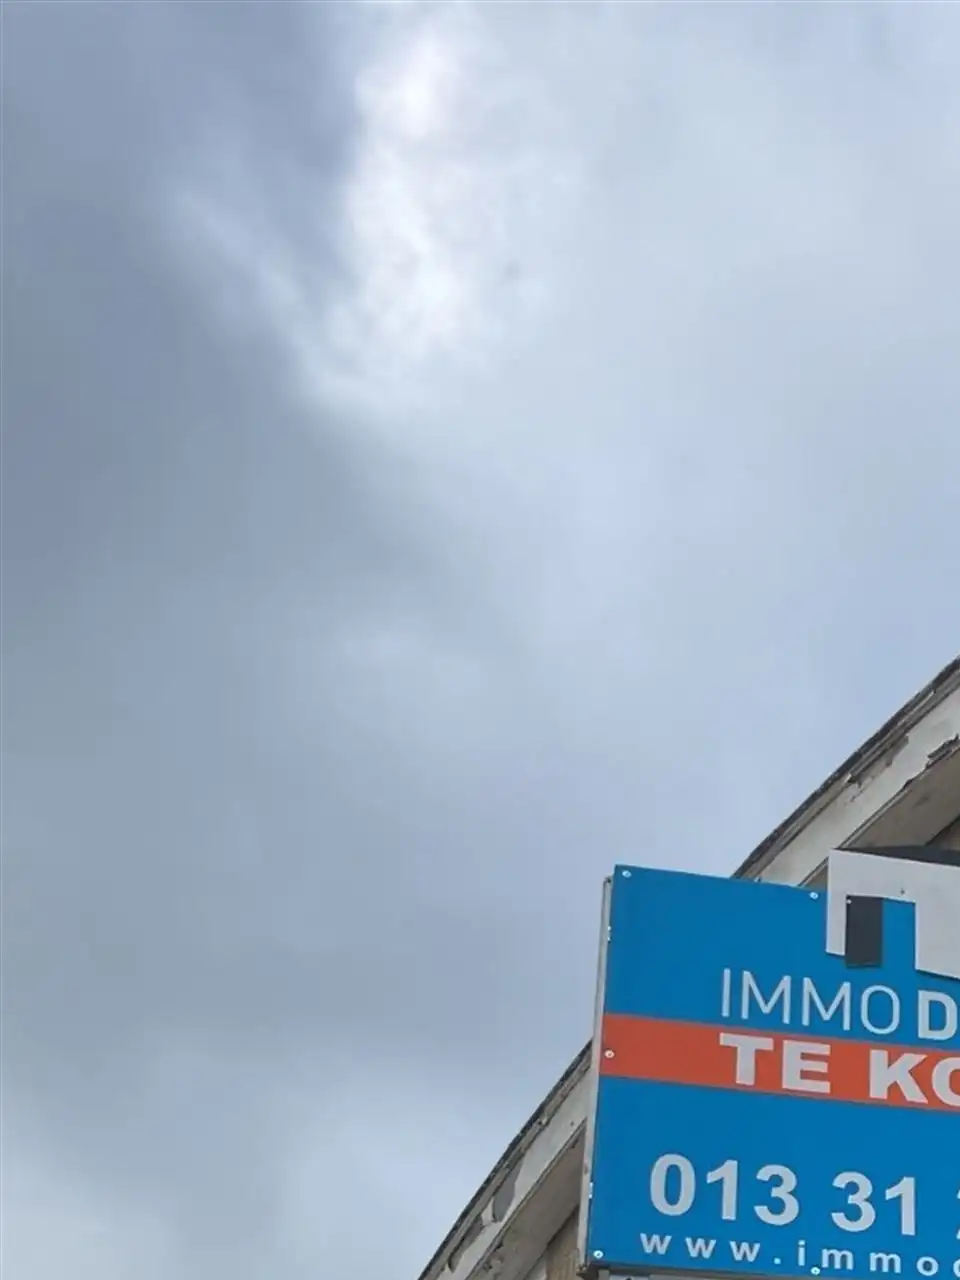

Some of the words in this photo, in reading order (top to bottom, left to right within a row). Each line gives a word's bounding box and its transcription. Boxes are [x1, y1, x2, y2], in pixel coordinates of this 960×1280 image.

[720, 967, 900, 1035] IMMO
[718, 1032, 831, 1095] TE
[649, 1153, 800, 1227] 013
[831, 1171, 917, 1237] 31
